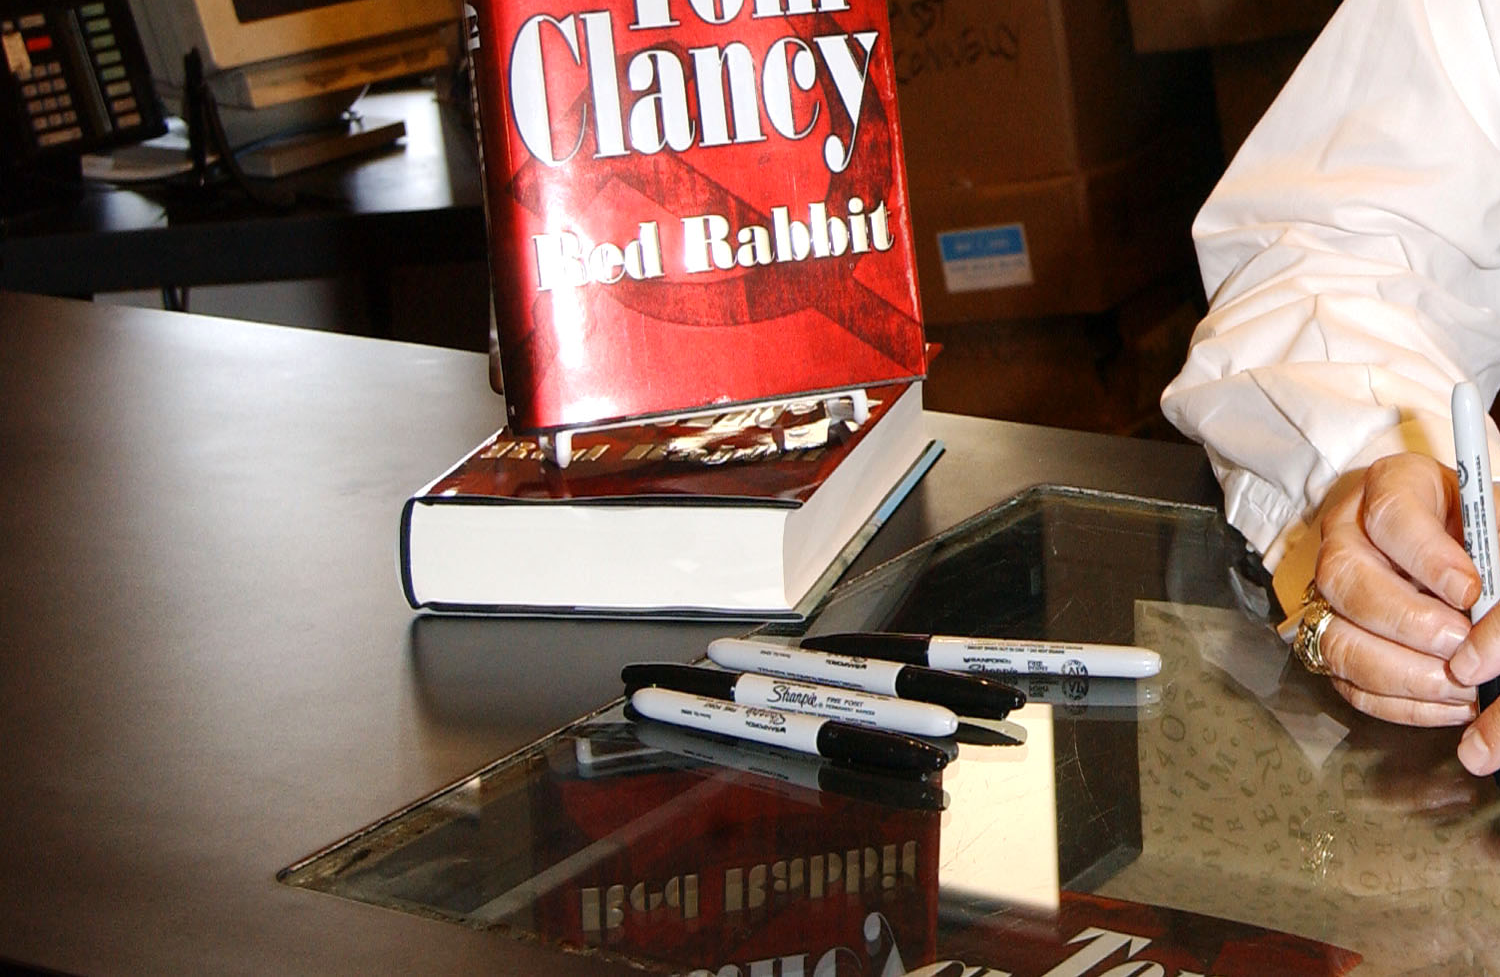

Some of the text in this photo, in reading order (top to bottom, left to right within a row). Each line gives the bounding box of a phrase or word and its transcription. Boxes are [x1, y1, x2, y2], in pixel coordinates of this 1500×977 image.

[508, 10, 879, 174] Clancy
[531, 197, 895, 292] Red Rabbit
[767, 684, 818, 707] Sharpie
